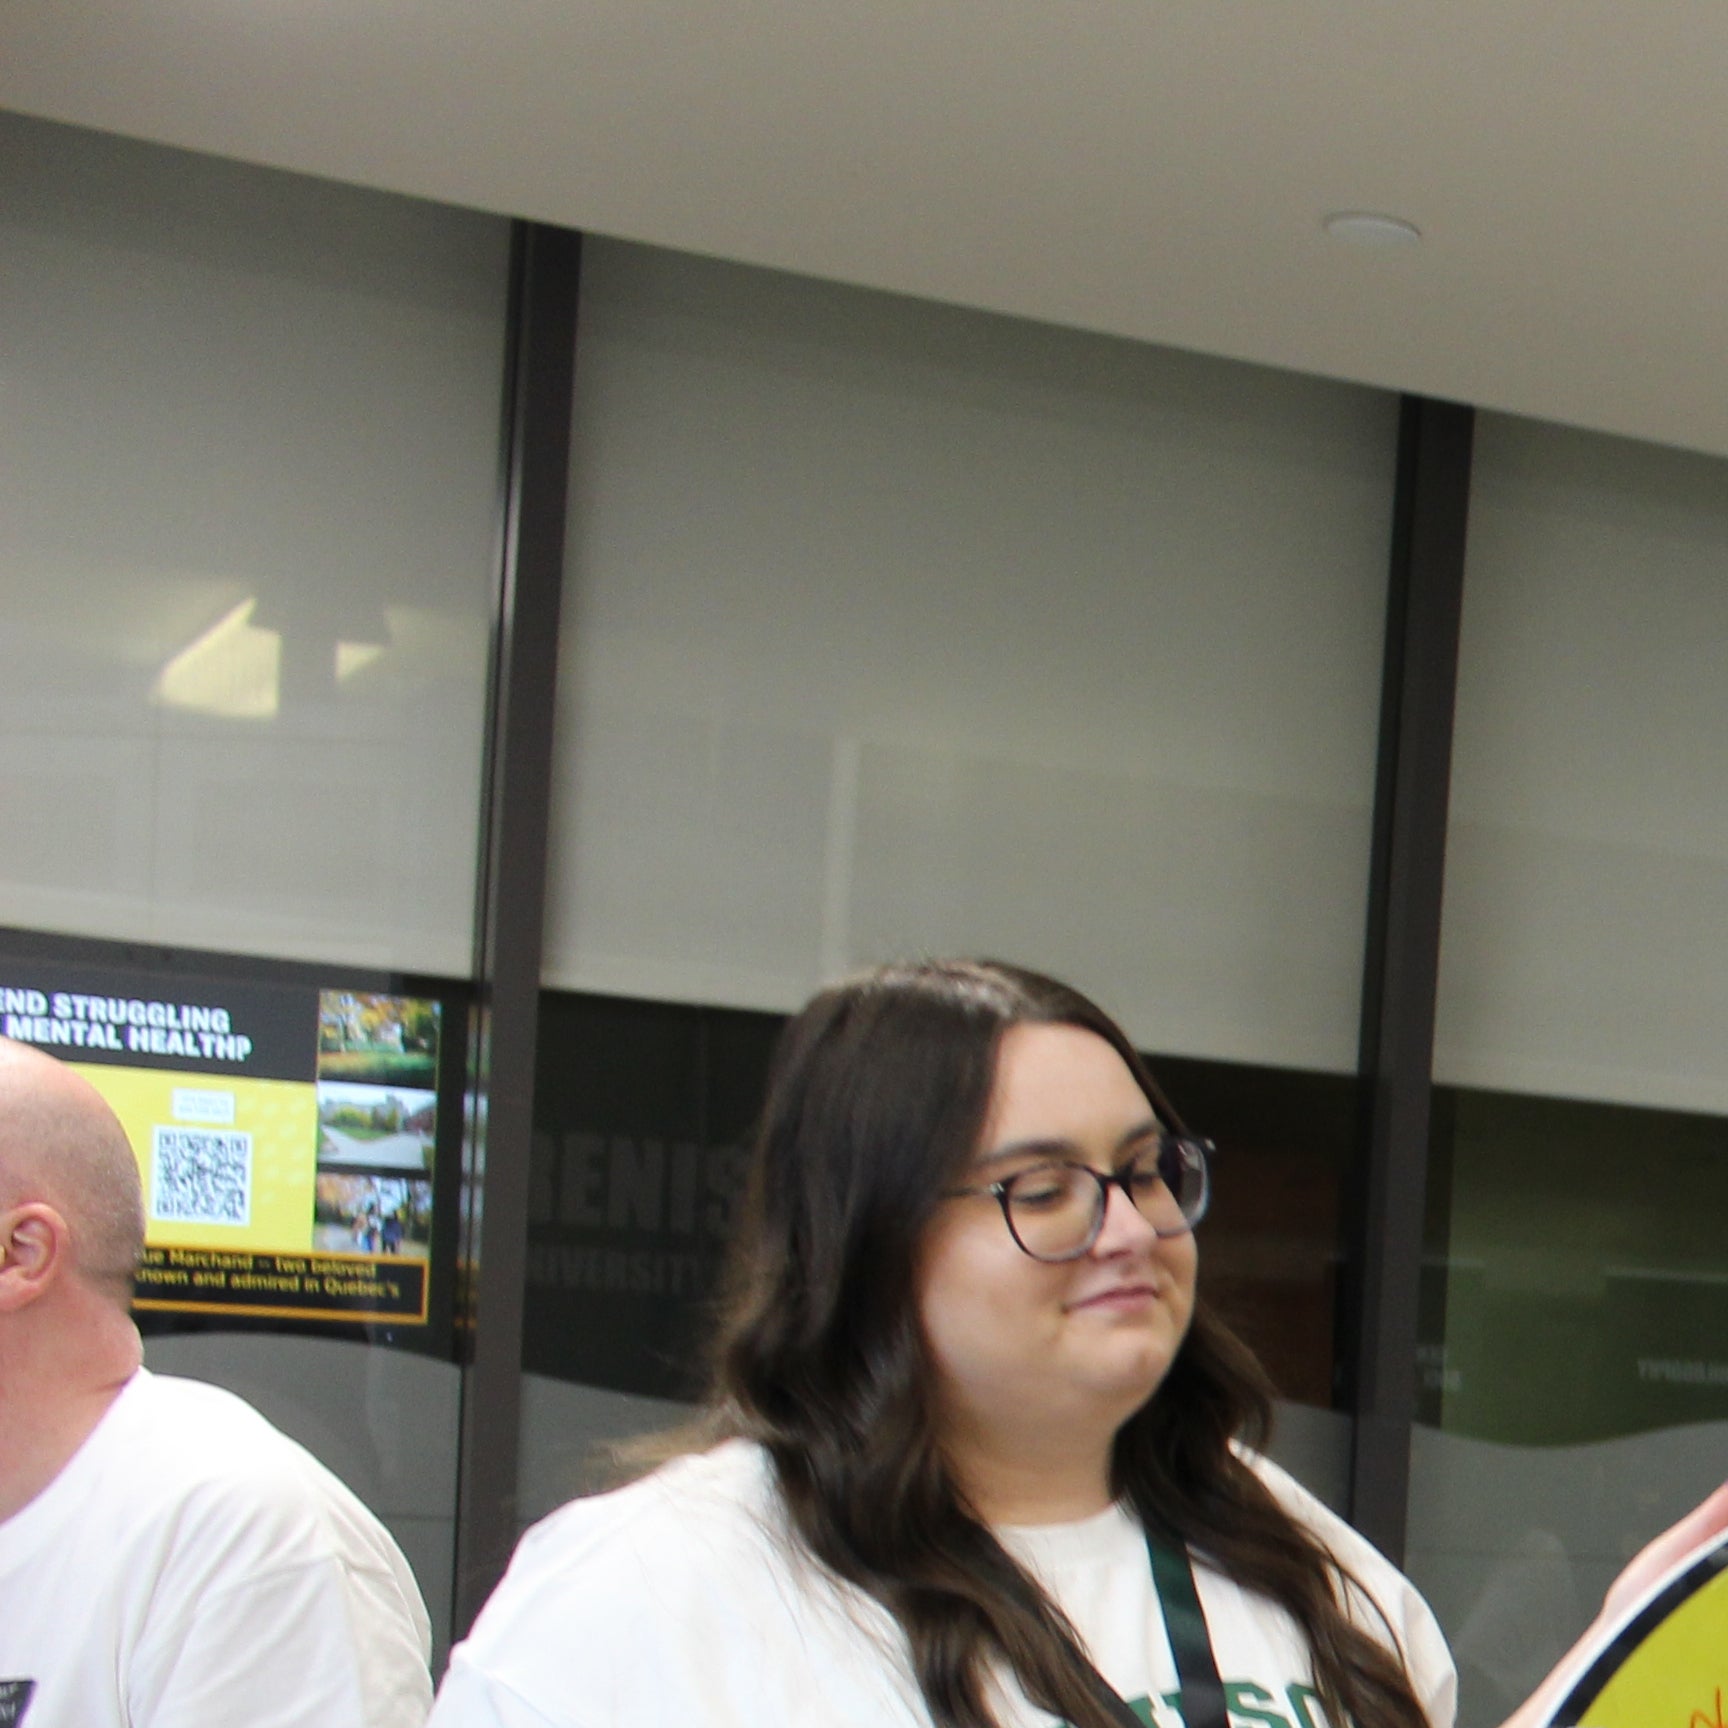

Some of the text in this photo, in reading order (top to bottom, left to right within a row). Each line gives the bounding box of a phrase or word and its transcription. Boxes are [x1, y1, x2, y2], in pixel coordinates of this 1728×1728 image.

[52, 991, 231, 1034] STRUGGLING
[6, 1014, 123, 1050] MENTAL
[169, 1250, 253, 1269] Marchand
[275, 1256, 305, 1273] two
[311, 1259, 377, 1279] beloved
[193, 1271, 226, 1288] and
[229, 1273, 300, 1292] admired
[304, 1276, 320, 1293] in
